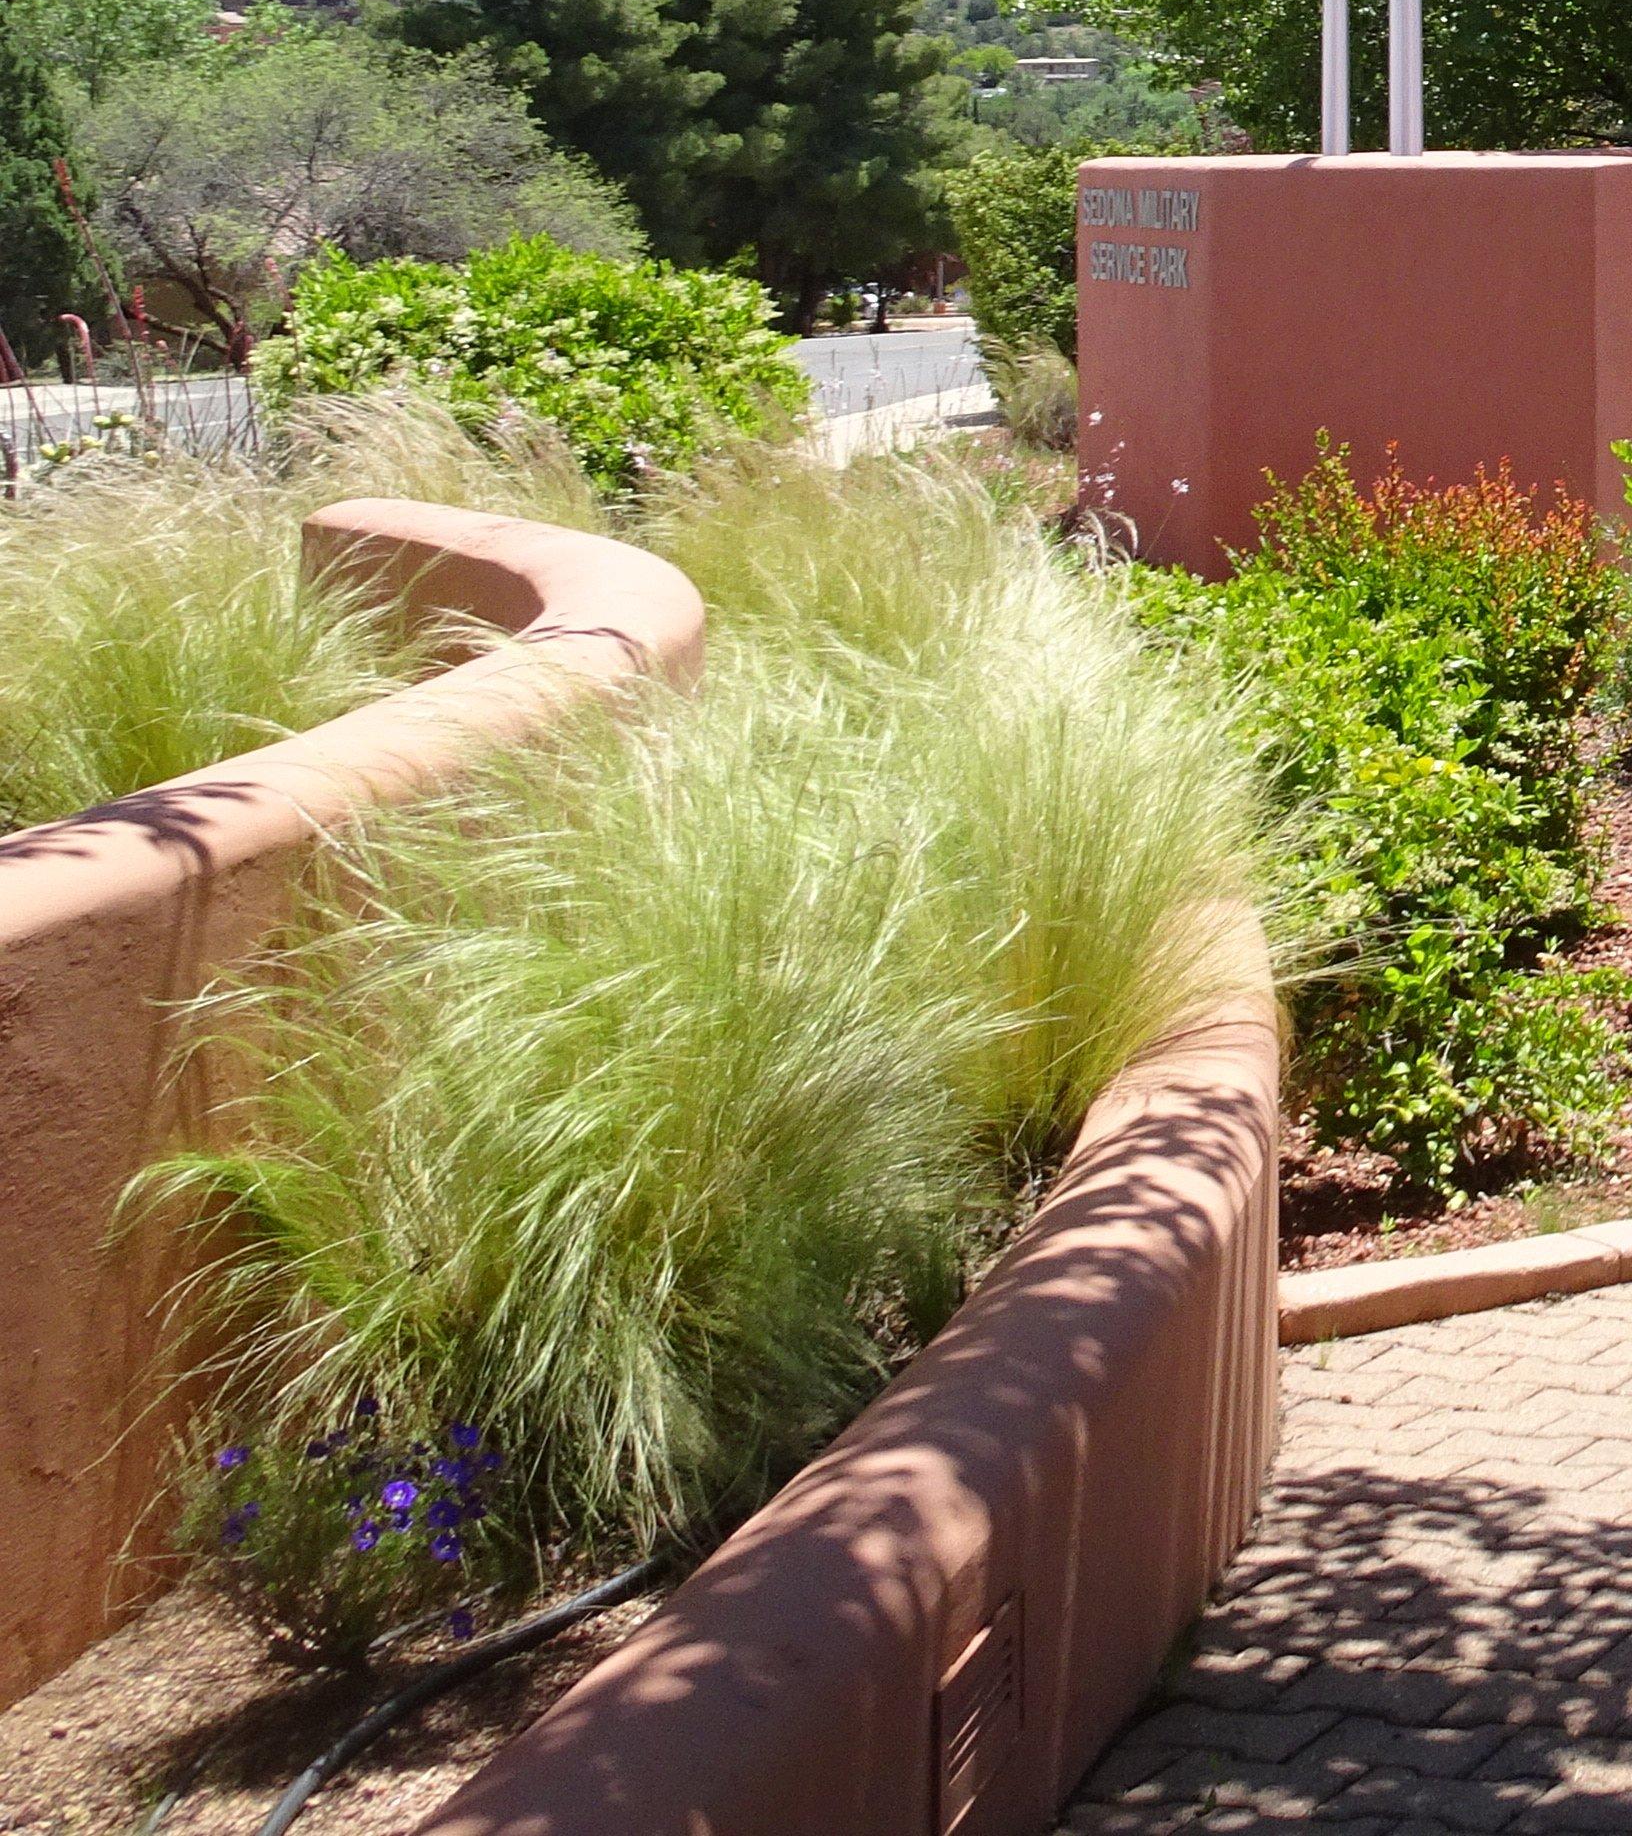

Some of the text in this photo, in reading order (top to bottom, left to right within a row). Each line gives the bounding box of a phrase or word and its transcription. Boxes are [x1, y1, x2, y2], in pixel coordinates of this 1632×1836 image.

[1083, 188, 1199, 231] SEDONA MILITARY
[1091, 242, 1188, 288] SERVICE PARK
